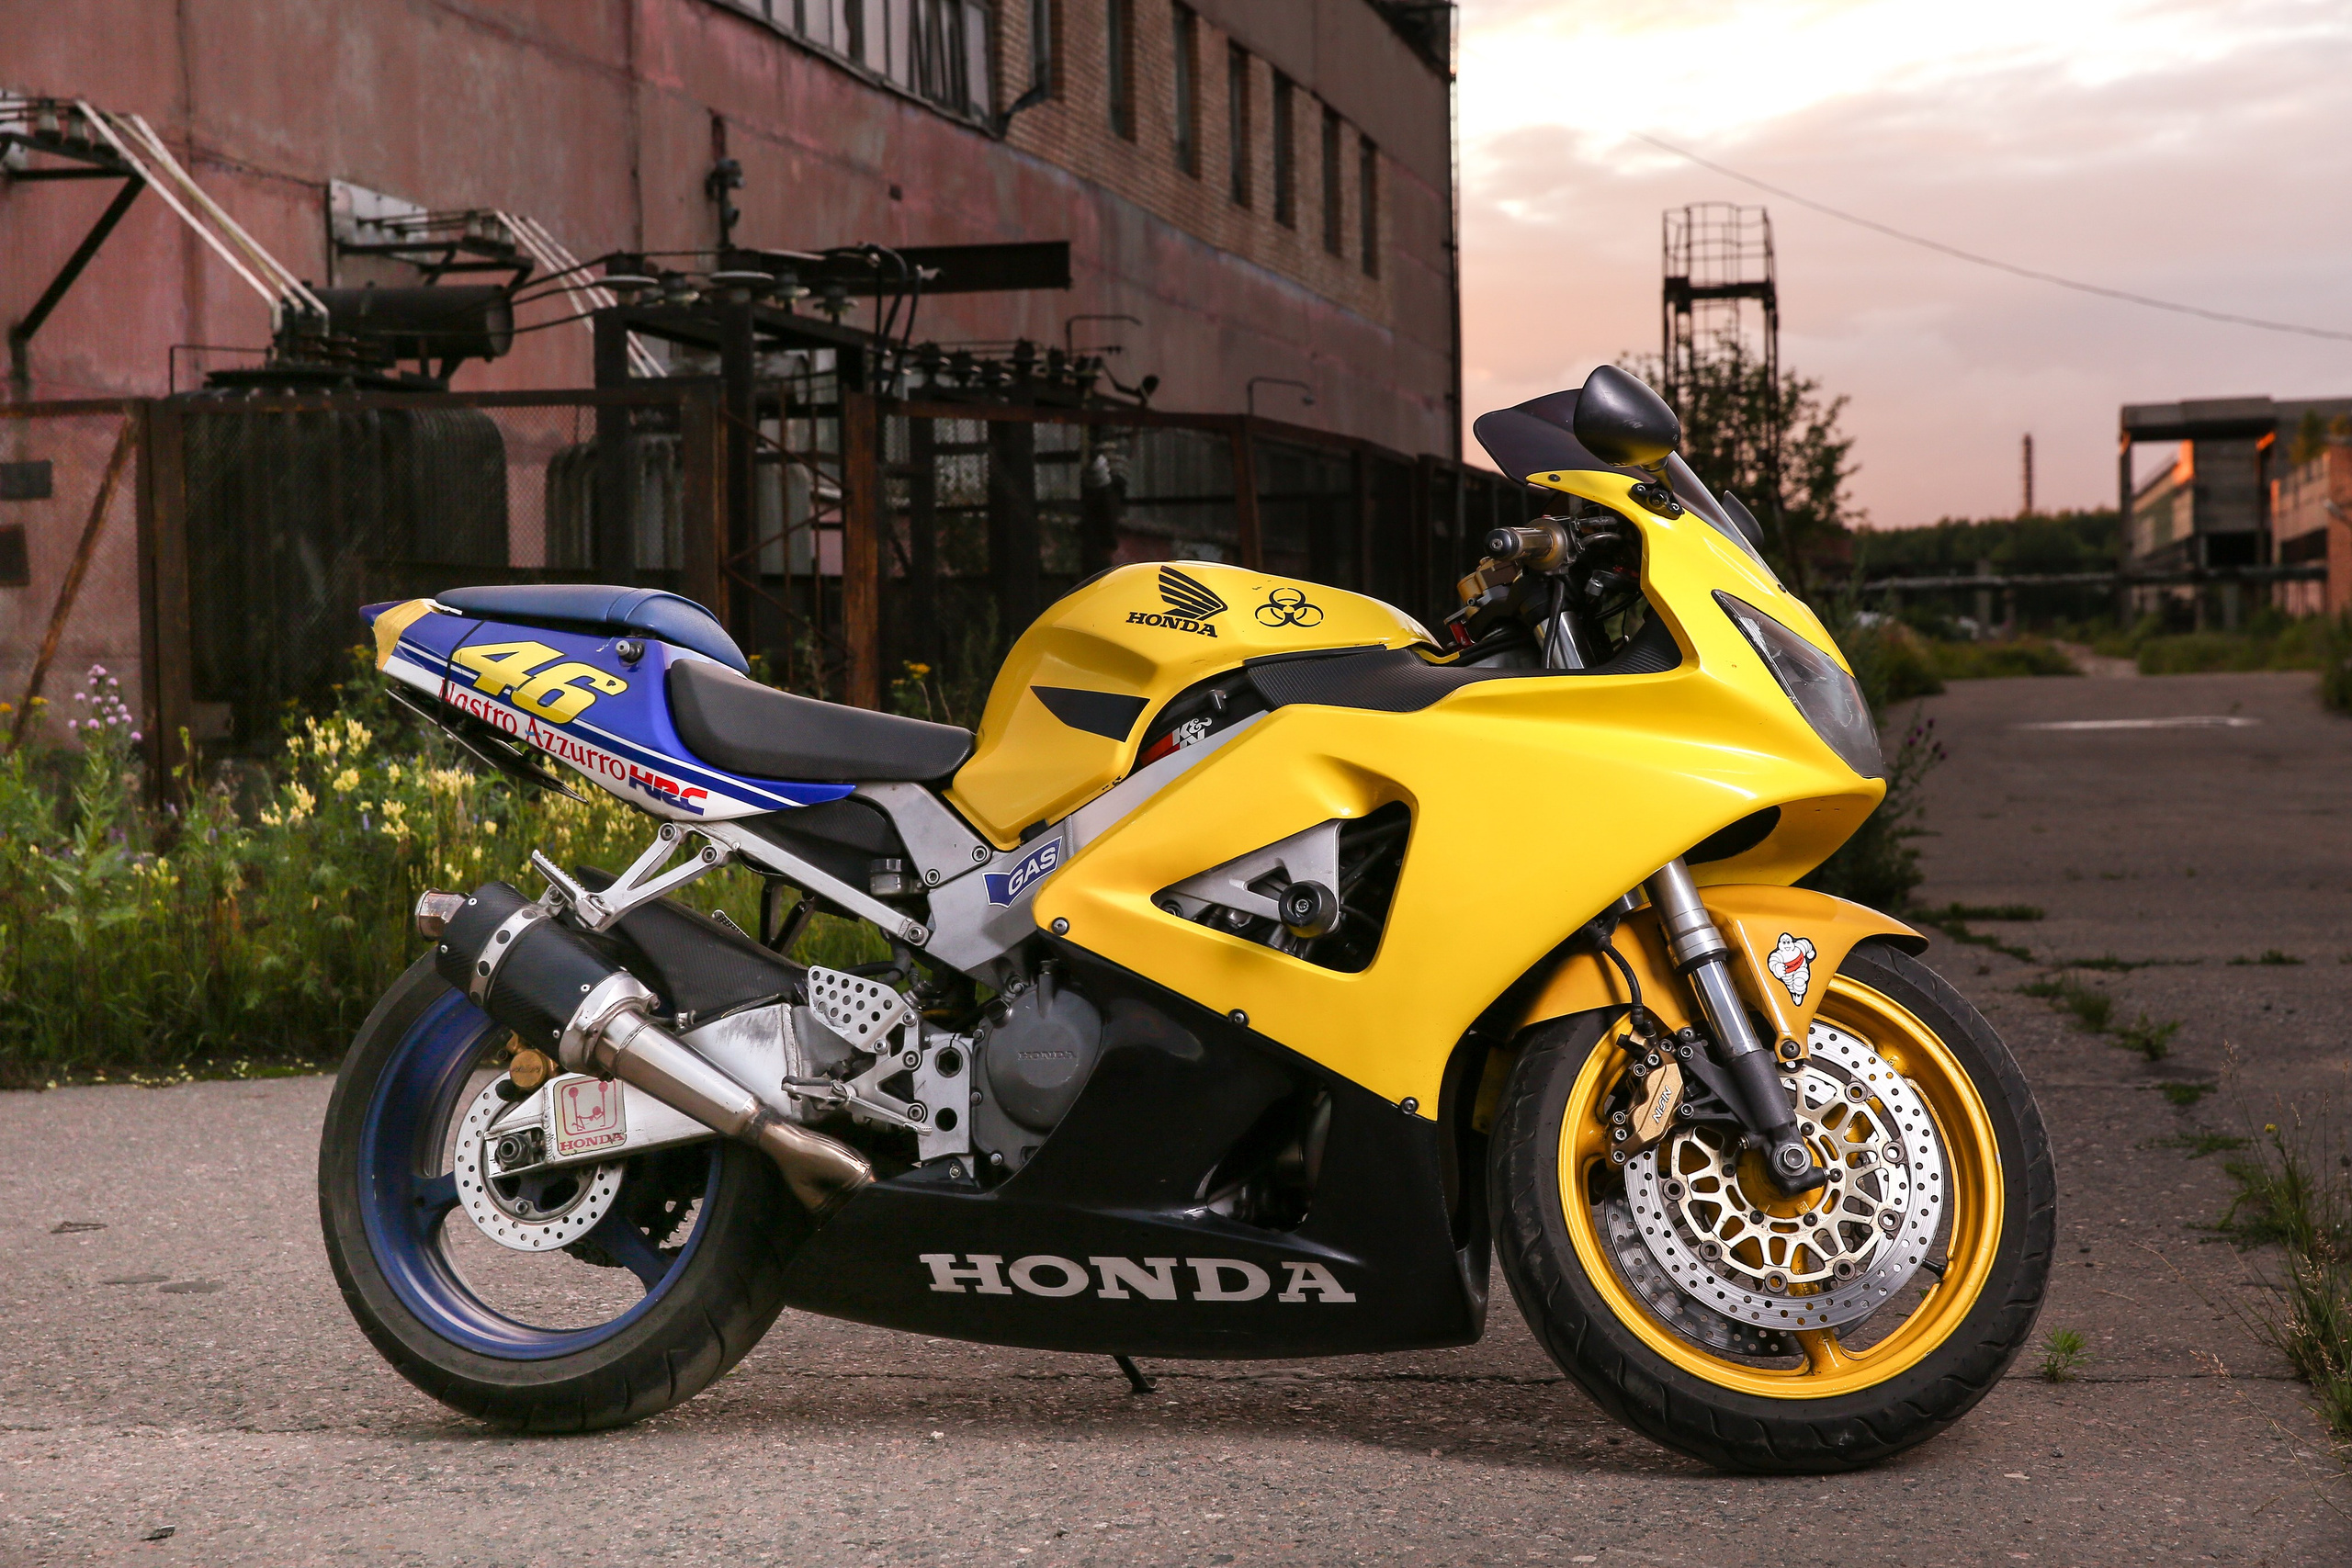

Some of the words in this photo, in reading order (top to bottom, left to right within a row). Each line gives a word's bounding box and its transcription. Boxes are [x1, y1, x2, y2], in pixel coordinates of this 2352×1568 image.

[1125, 611, 1218, 638] HONDA
[450, 640, 629, 725] 46
[438, 678, 518, 736] Nastro
[525, 716, 627, 781] Azzurro
[628, 764, 708, 817] HRC
[1008, 846, 1057, 896] GAS
[1017, 1050, 1077, 1061] HONDA
[560, 1132, 625, 1152] HONDA
[919, 1253, 1358, 1303] HONDA
